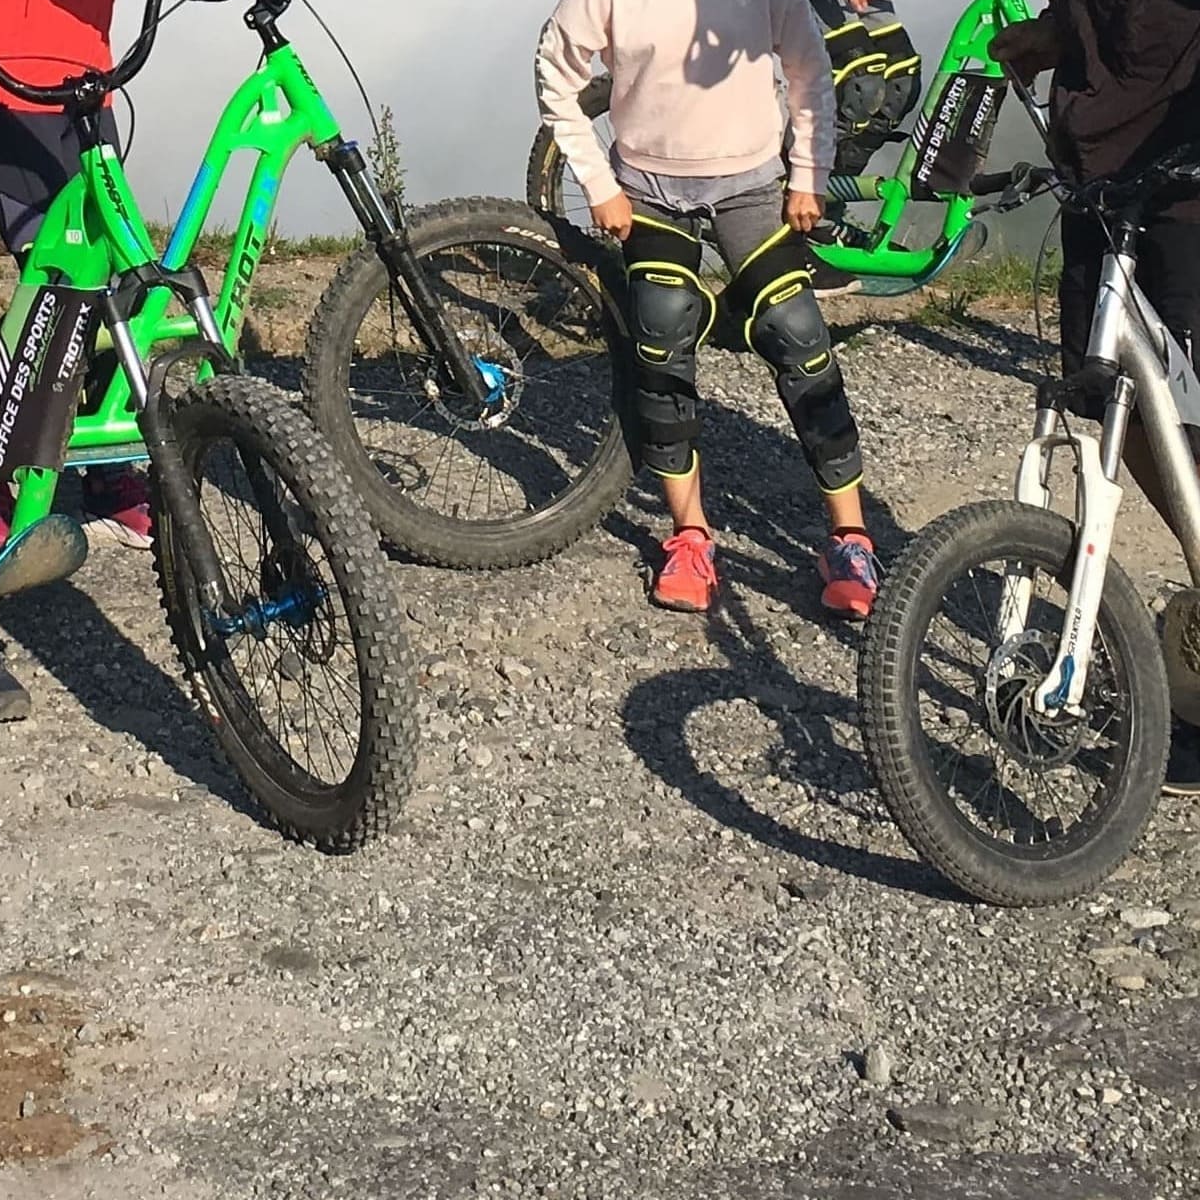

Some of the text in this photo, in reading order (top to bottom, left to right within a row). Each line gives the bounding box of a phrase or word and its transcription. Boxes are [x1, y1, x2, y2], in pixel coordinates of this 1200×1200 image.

[930, 121, 947, 147] DES
[939, 76, 968, 123] SPORTS
[970, 85, 996, 136] TROTRX
[10, 361, 31, 401] DES
[23, 291, 57, 362] SPORTS
[57, 302, 93, 379] TROTRX
